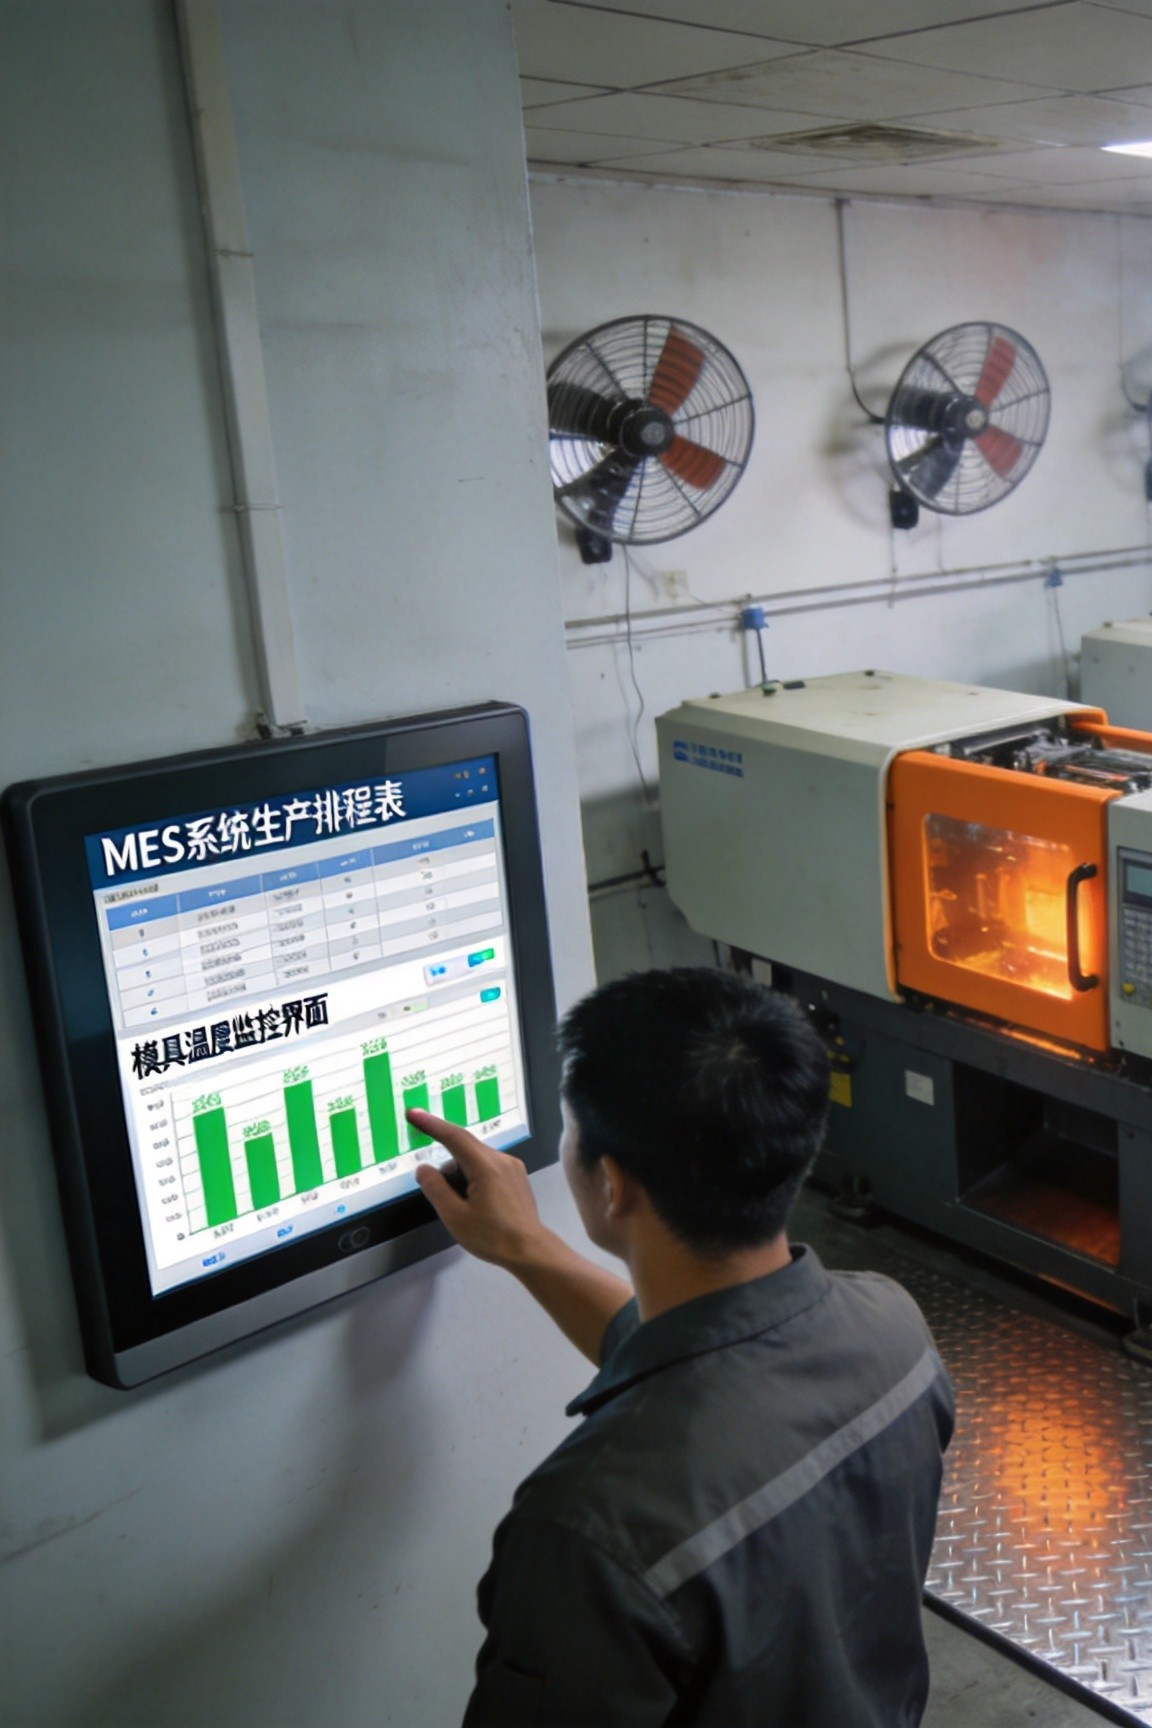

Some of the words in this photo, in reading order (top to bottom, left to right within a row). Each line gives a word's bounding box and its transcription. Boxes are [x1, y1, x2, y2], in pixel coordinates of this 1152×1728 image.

[101, 780, 407, 876] MES系统生产排程表
